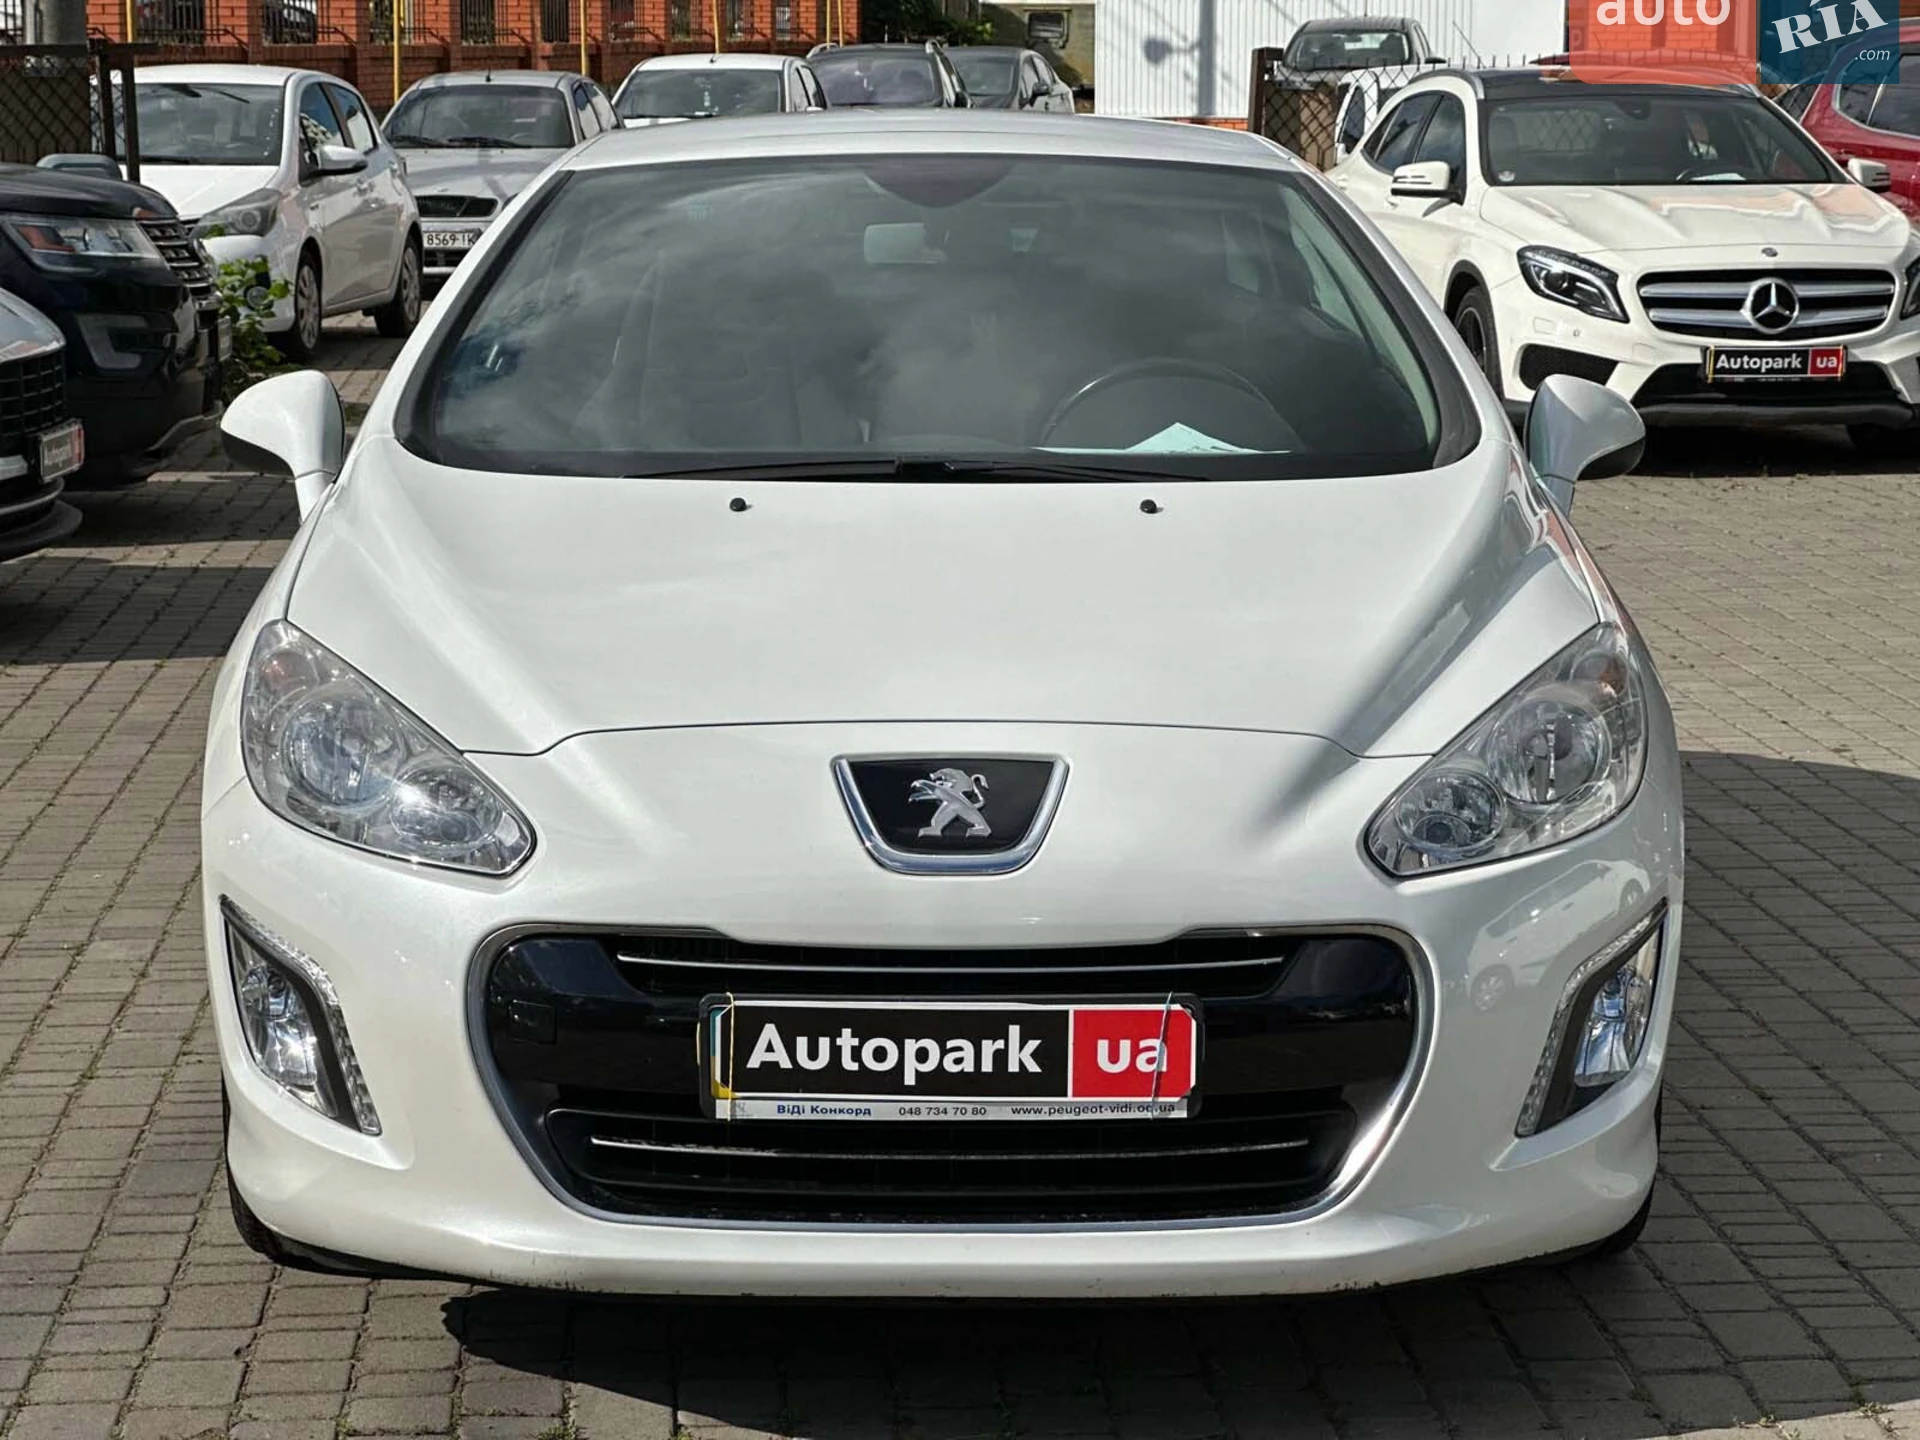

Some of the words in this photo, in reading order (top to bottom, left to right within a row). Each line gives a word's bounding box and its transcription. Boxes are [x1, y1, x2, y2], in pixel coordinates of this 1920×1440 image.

[426, 233, 457, 246] 8569
[1715, 353, 1802, 373] Autopark
[1816, 356, 1838, 368] ua
[745, 1022, 1043, 1086] Autopark
[1096, 1038, 1168, 1073] ua
[809, 1105, 872, 1117] Конкорд
[898, 1107, 922, 1117] 048
[925, 1106, 948, 1117] 734
[952, 1106, 968, 1116] 70
[971, 1106, 987, 1116] 80
